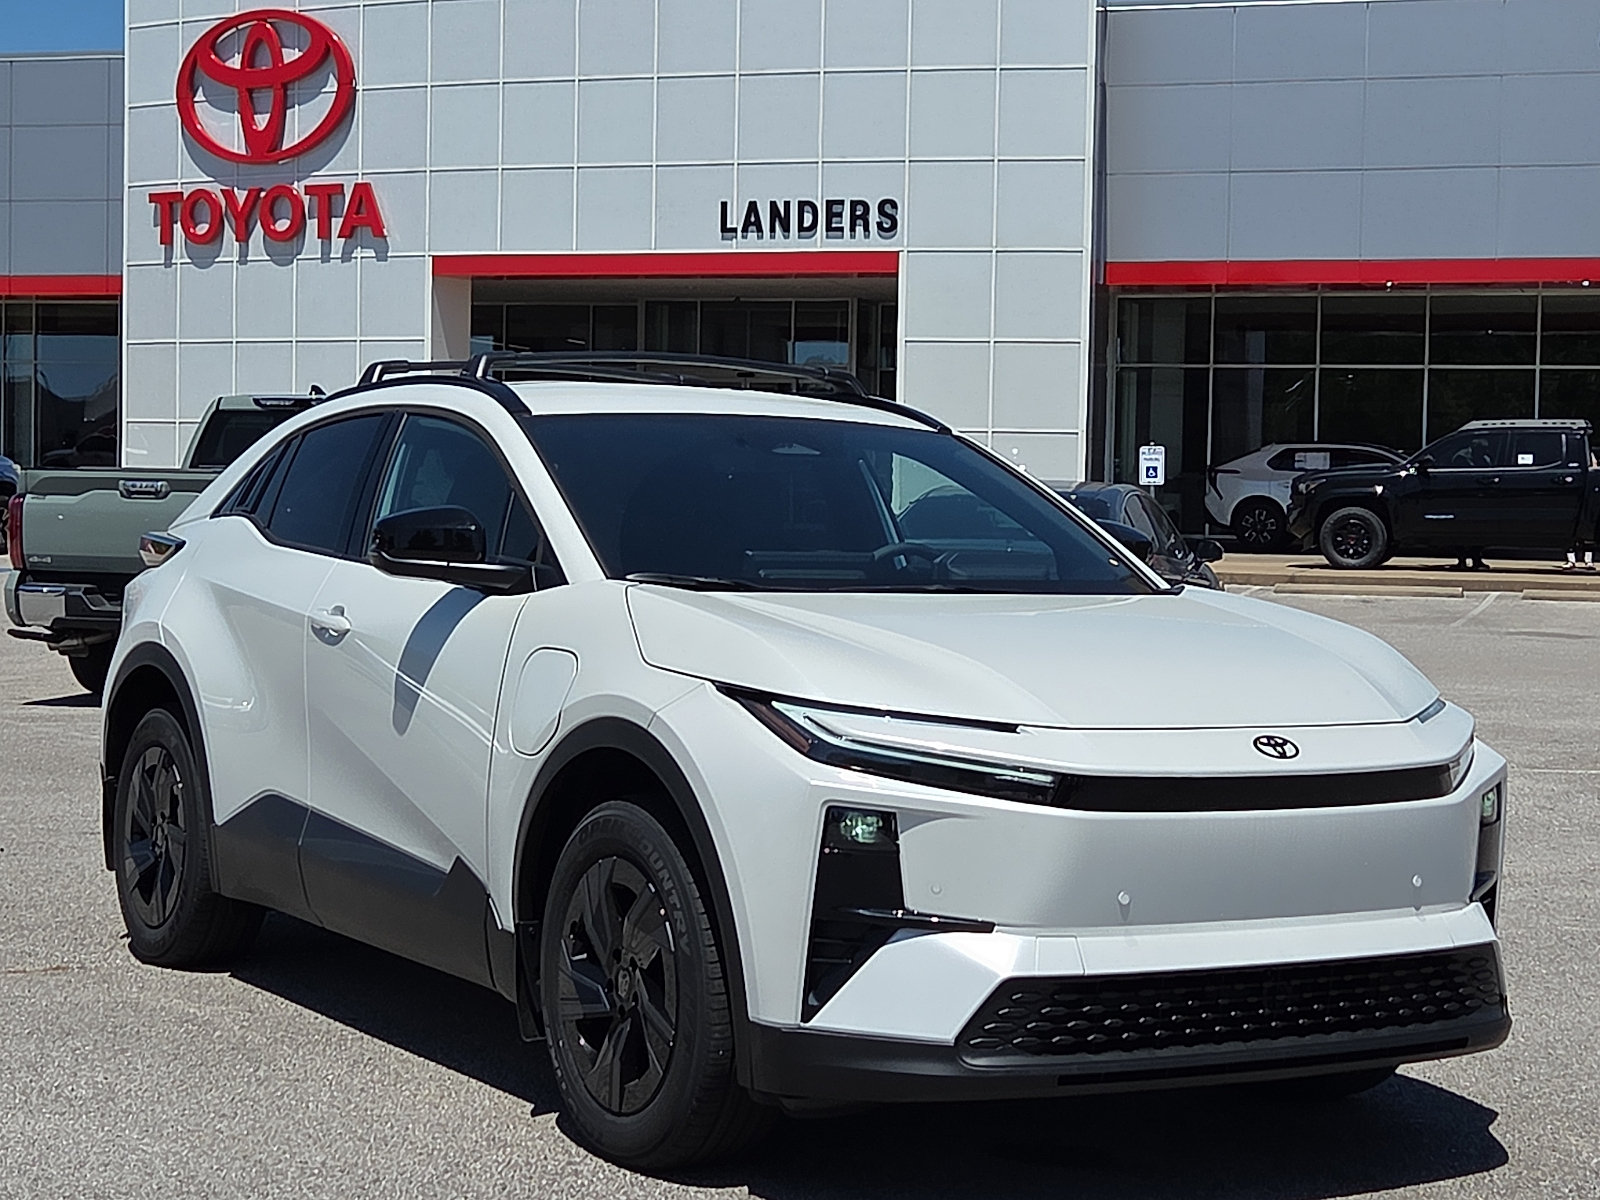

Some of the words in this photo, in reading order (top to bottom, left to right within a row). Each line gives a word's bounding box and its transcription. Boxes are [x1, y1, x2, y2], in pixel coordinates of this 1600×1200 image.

[149, 181, 388, 246] TOYOTA
[720, 198, 899, 239] LANDERS
[633, 829, 692, 956] OUNTRY
